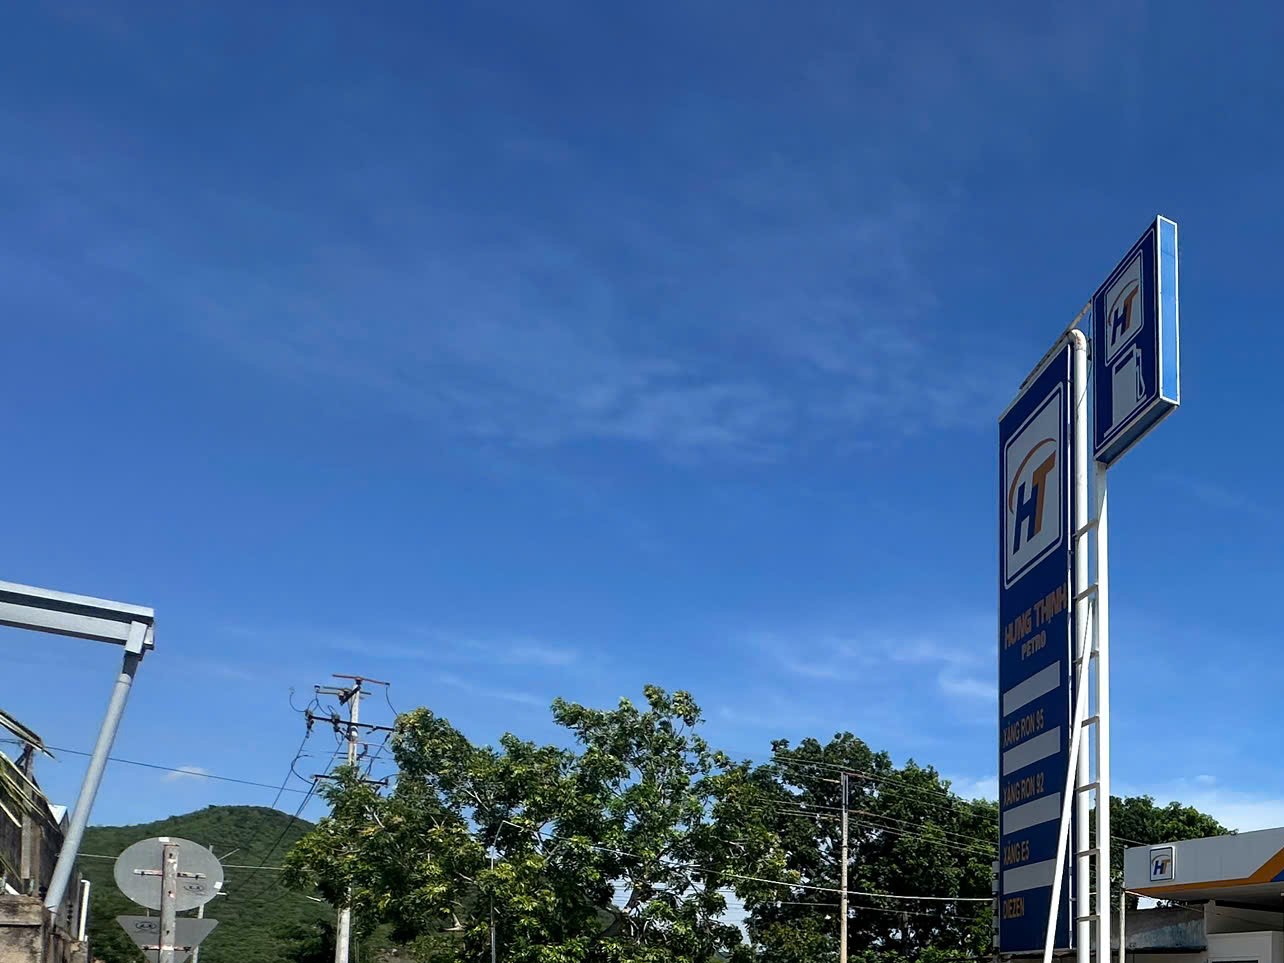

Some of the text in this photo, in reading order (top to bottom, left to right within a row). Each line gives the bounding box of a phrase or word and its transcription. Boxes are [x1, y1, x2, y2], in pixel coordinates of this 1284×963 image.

[1110, 283, 1139, 348] HT
[1012, 448, 1057, 556] HT
[1021, 630, 1047, 660] PETRO
[1021, 713, 1035, 738] RON
[1036, 707, 1044, 730] 95
[1021, 775, 1036, 800] RON
[1036, 771, 1044, 793] 92
[1021, 839, 1030, 861] E5
[1153, 859, 1170, 875] HT
